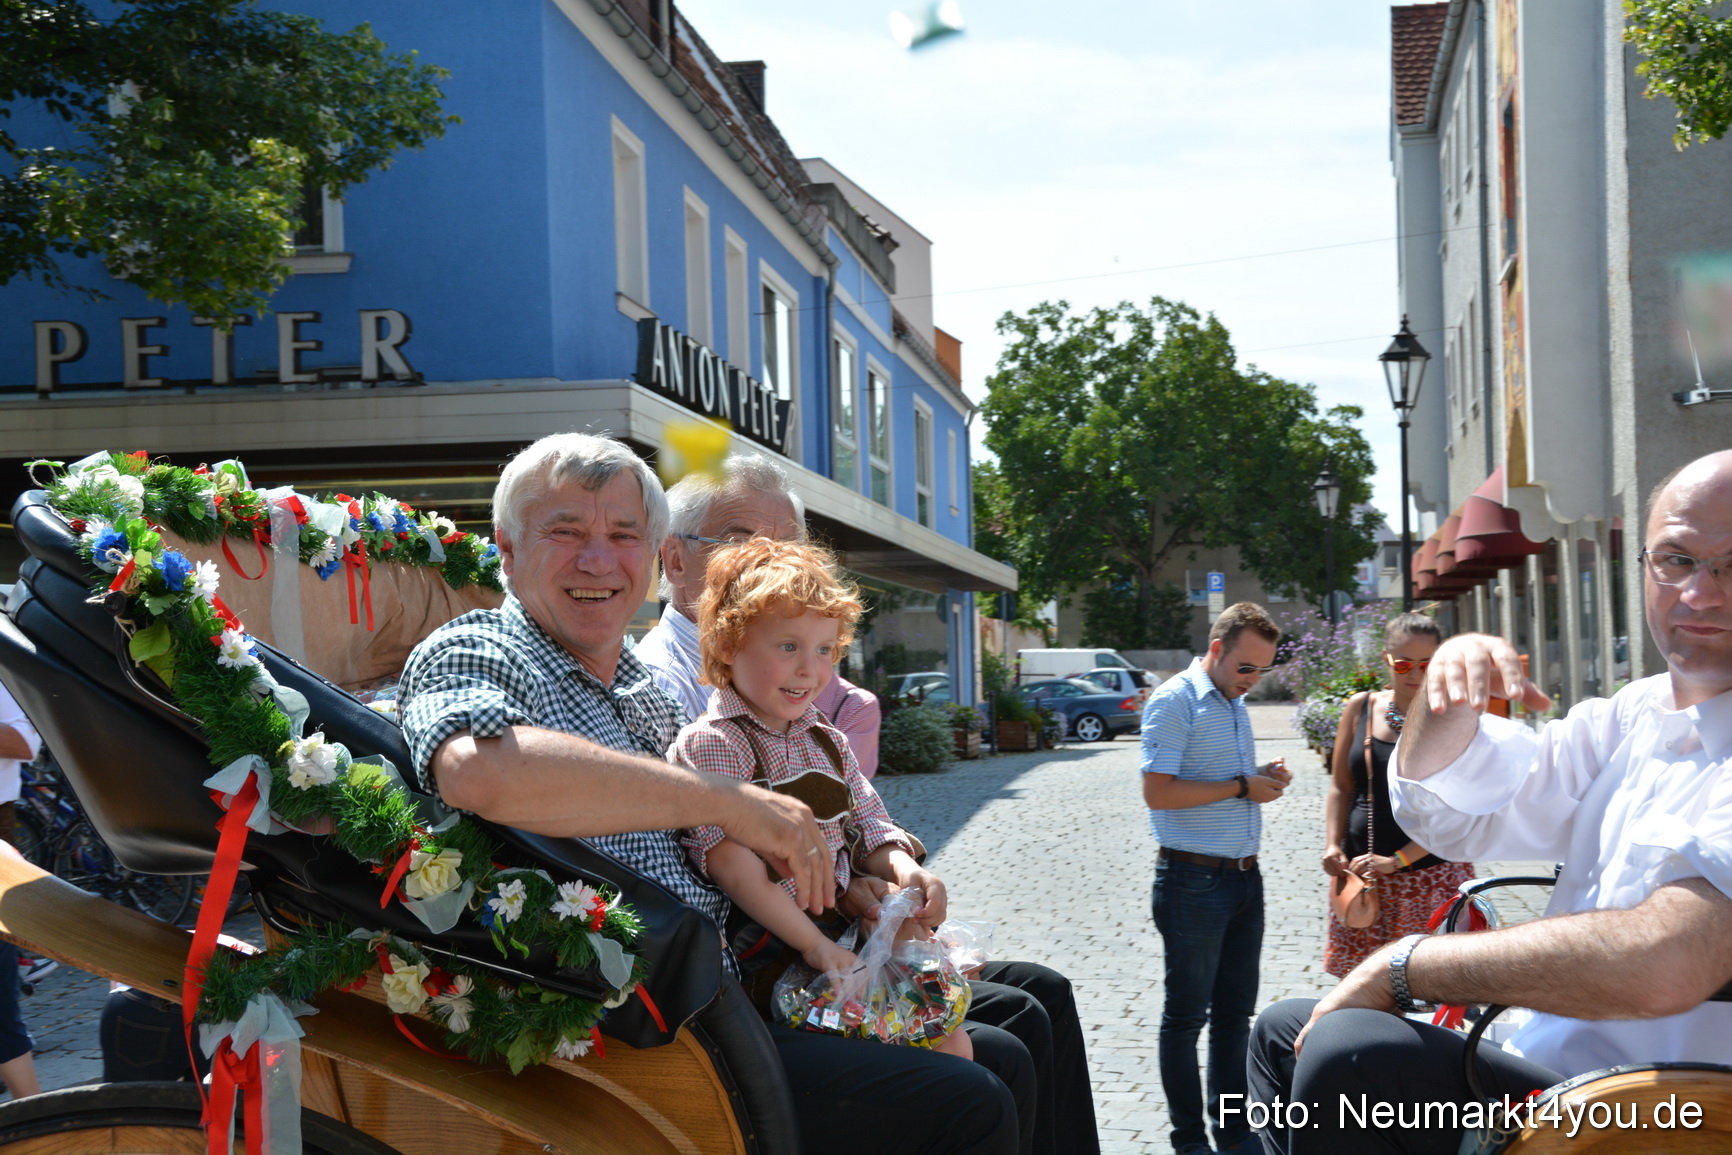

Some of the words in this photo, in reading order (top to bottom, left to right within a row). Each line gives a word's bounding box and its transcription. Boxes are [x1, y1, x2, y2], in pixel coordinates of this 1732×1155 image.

[34, 309, 424, 392] PETER
[652, 318, 731, 420] ANTON
[737, 369, 797, 457] PETER
[1211, 575, 1222, 590] P
